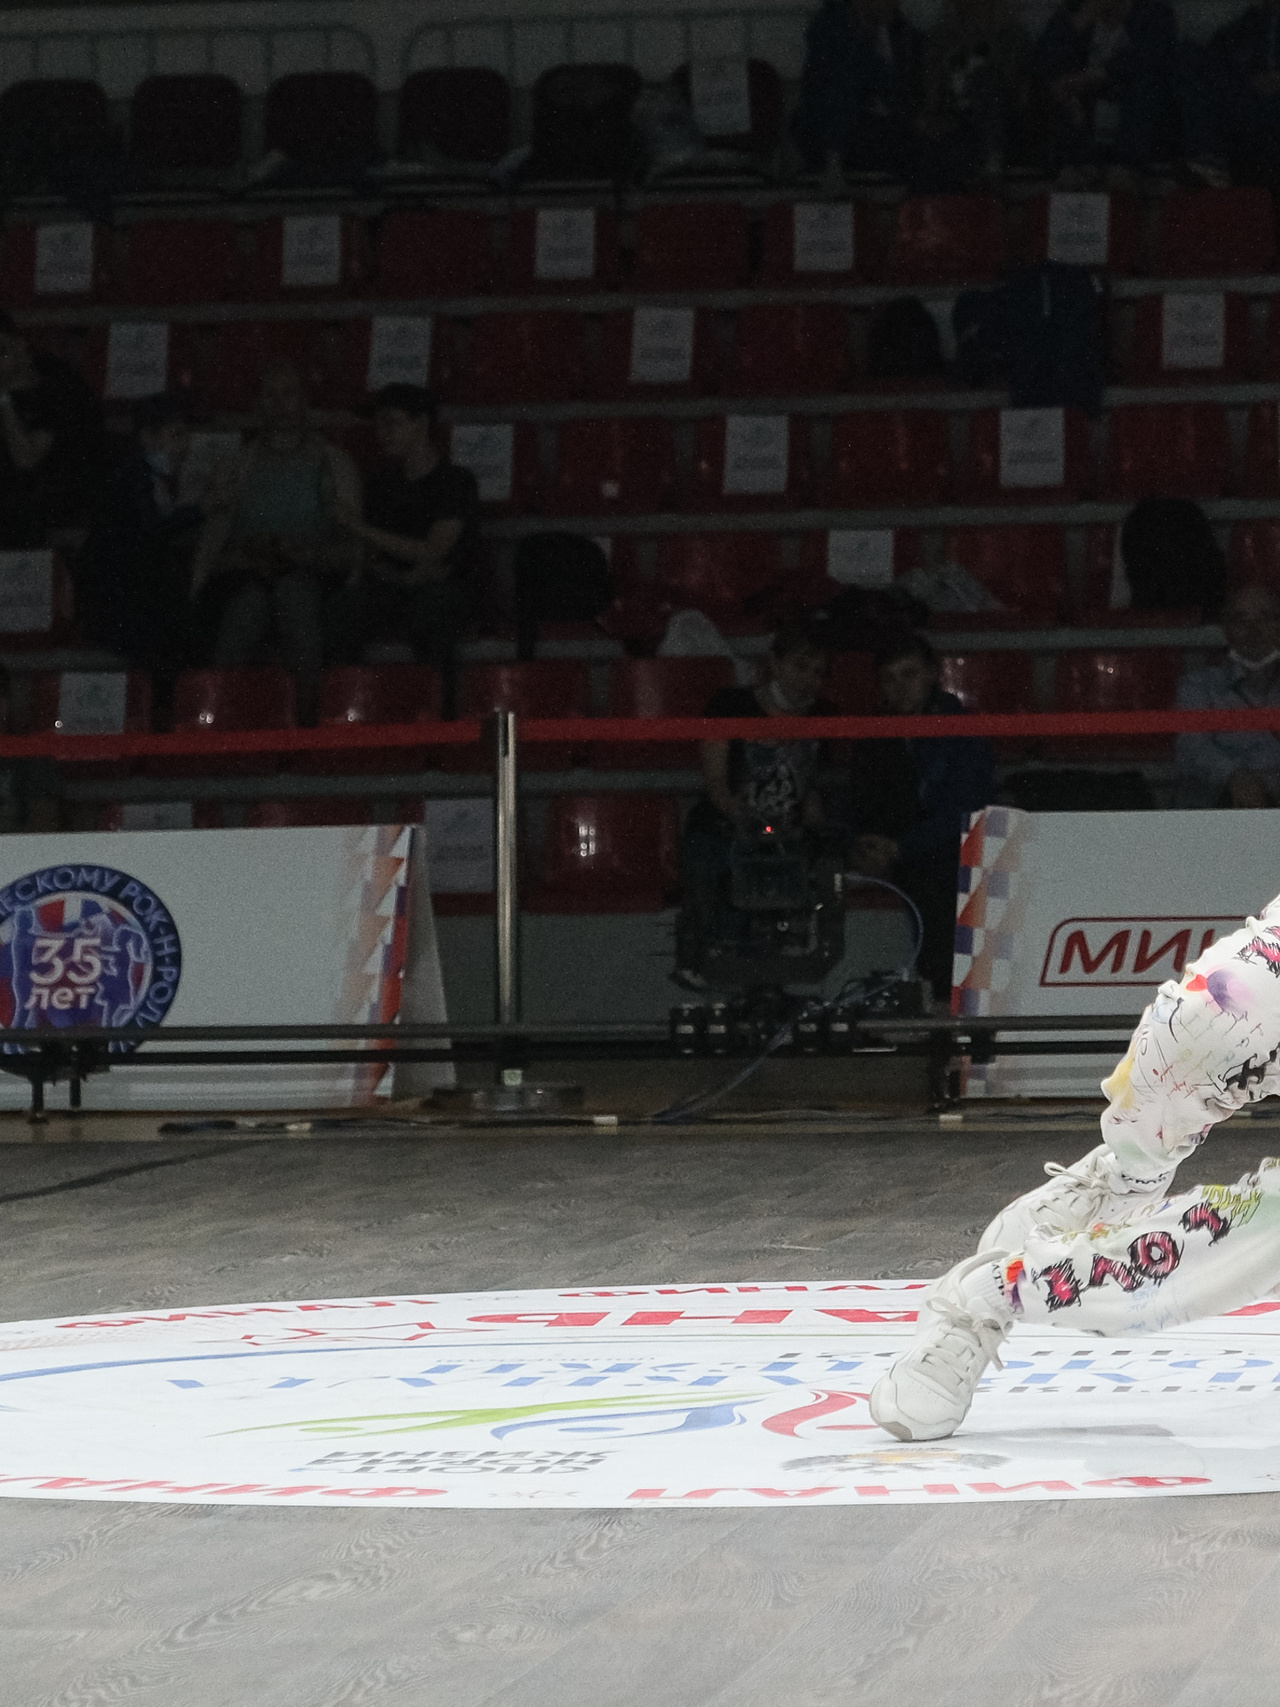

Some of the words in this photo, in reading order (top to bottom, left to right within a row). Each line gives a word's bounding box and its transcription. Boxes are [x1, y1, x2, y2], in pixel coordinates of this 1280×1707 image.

[28, 937, 102, 985] 35
[24, 985, 96, 1010] лет
[56, 1299, 439, 1329] ФИНАЛ
[624, 1475, 1212, 1500] ФИНАЛ
